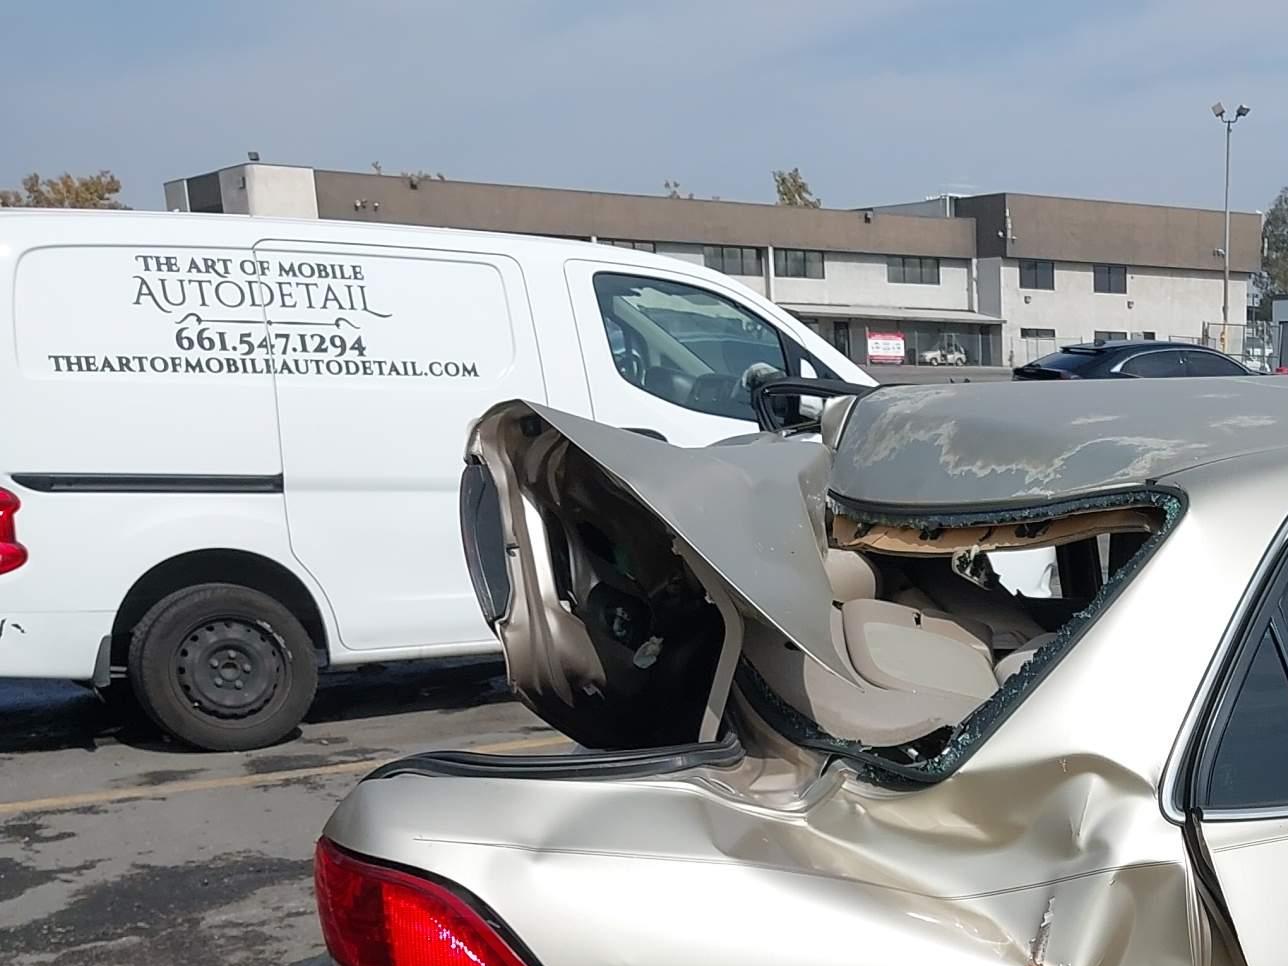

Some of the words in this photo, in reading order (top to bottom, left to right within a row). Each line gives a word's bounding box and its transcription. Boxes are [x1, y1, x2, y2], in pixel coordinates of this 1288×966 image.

[135, 255, 180, 272] THE
[187, 258, 232, 278] ART
[239, 260, 270, 277] OF
[278, 261, 364, 281] MOBILE
[132, 275, 392, 318] AUTODETAIL
[175, 327, 367, 357] 661.547.1294
[48, 355, 480, 377] THEARTOFMOBILEAUTODETAIL.COM
